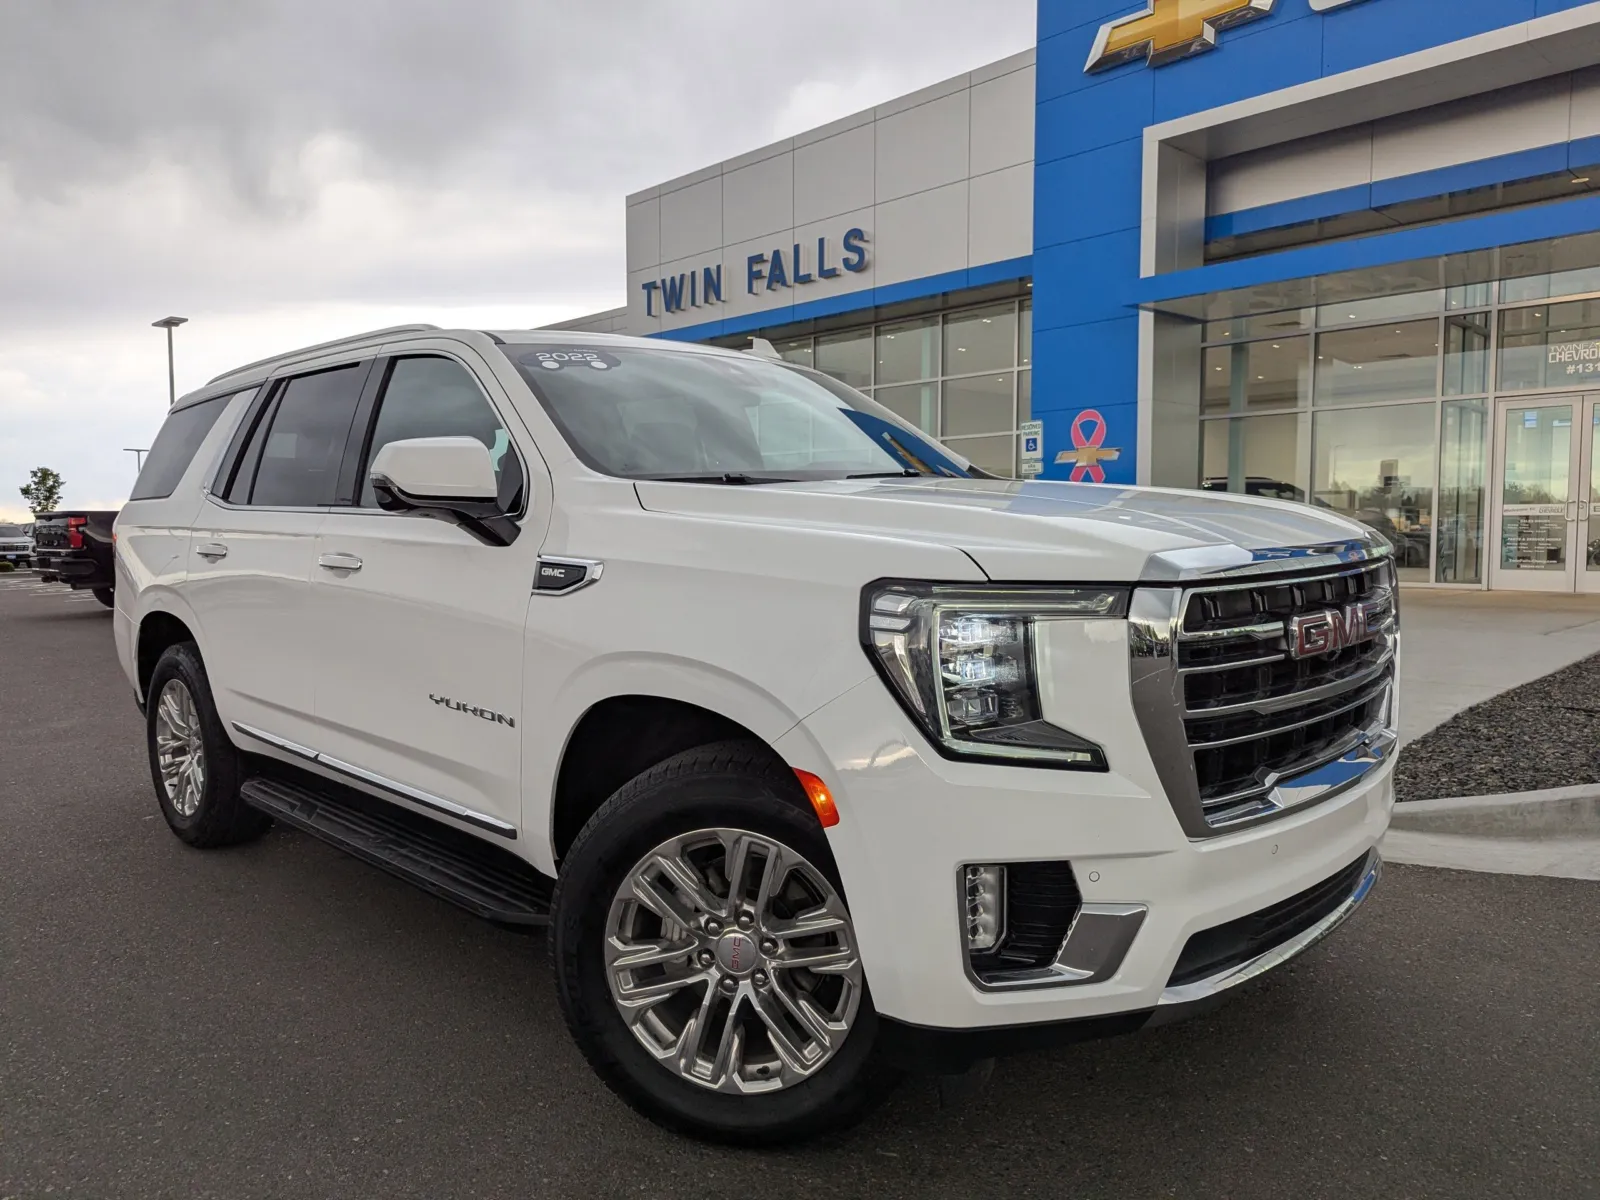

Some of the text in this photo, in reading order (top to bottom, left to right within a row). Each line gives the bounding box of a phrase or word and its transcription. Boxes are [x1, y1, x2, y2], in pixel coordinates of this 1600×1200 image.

[641, 227, 870, 318] TWIN FALLS
[535, 352, 602, 362] 2022
[1548, 348, 1600, 363] CHEVRO
[541, 567, 566, 578] GMC
[1290, 602, 1380, 660] GMC
[428, 692, 515, 728] YUKON
[731, 937, 741, 970] GMC
